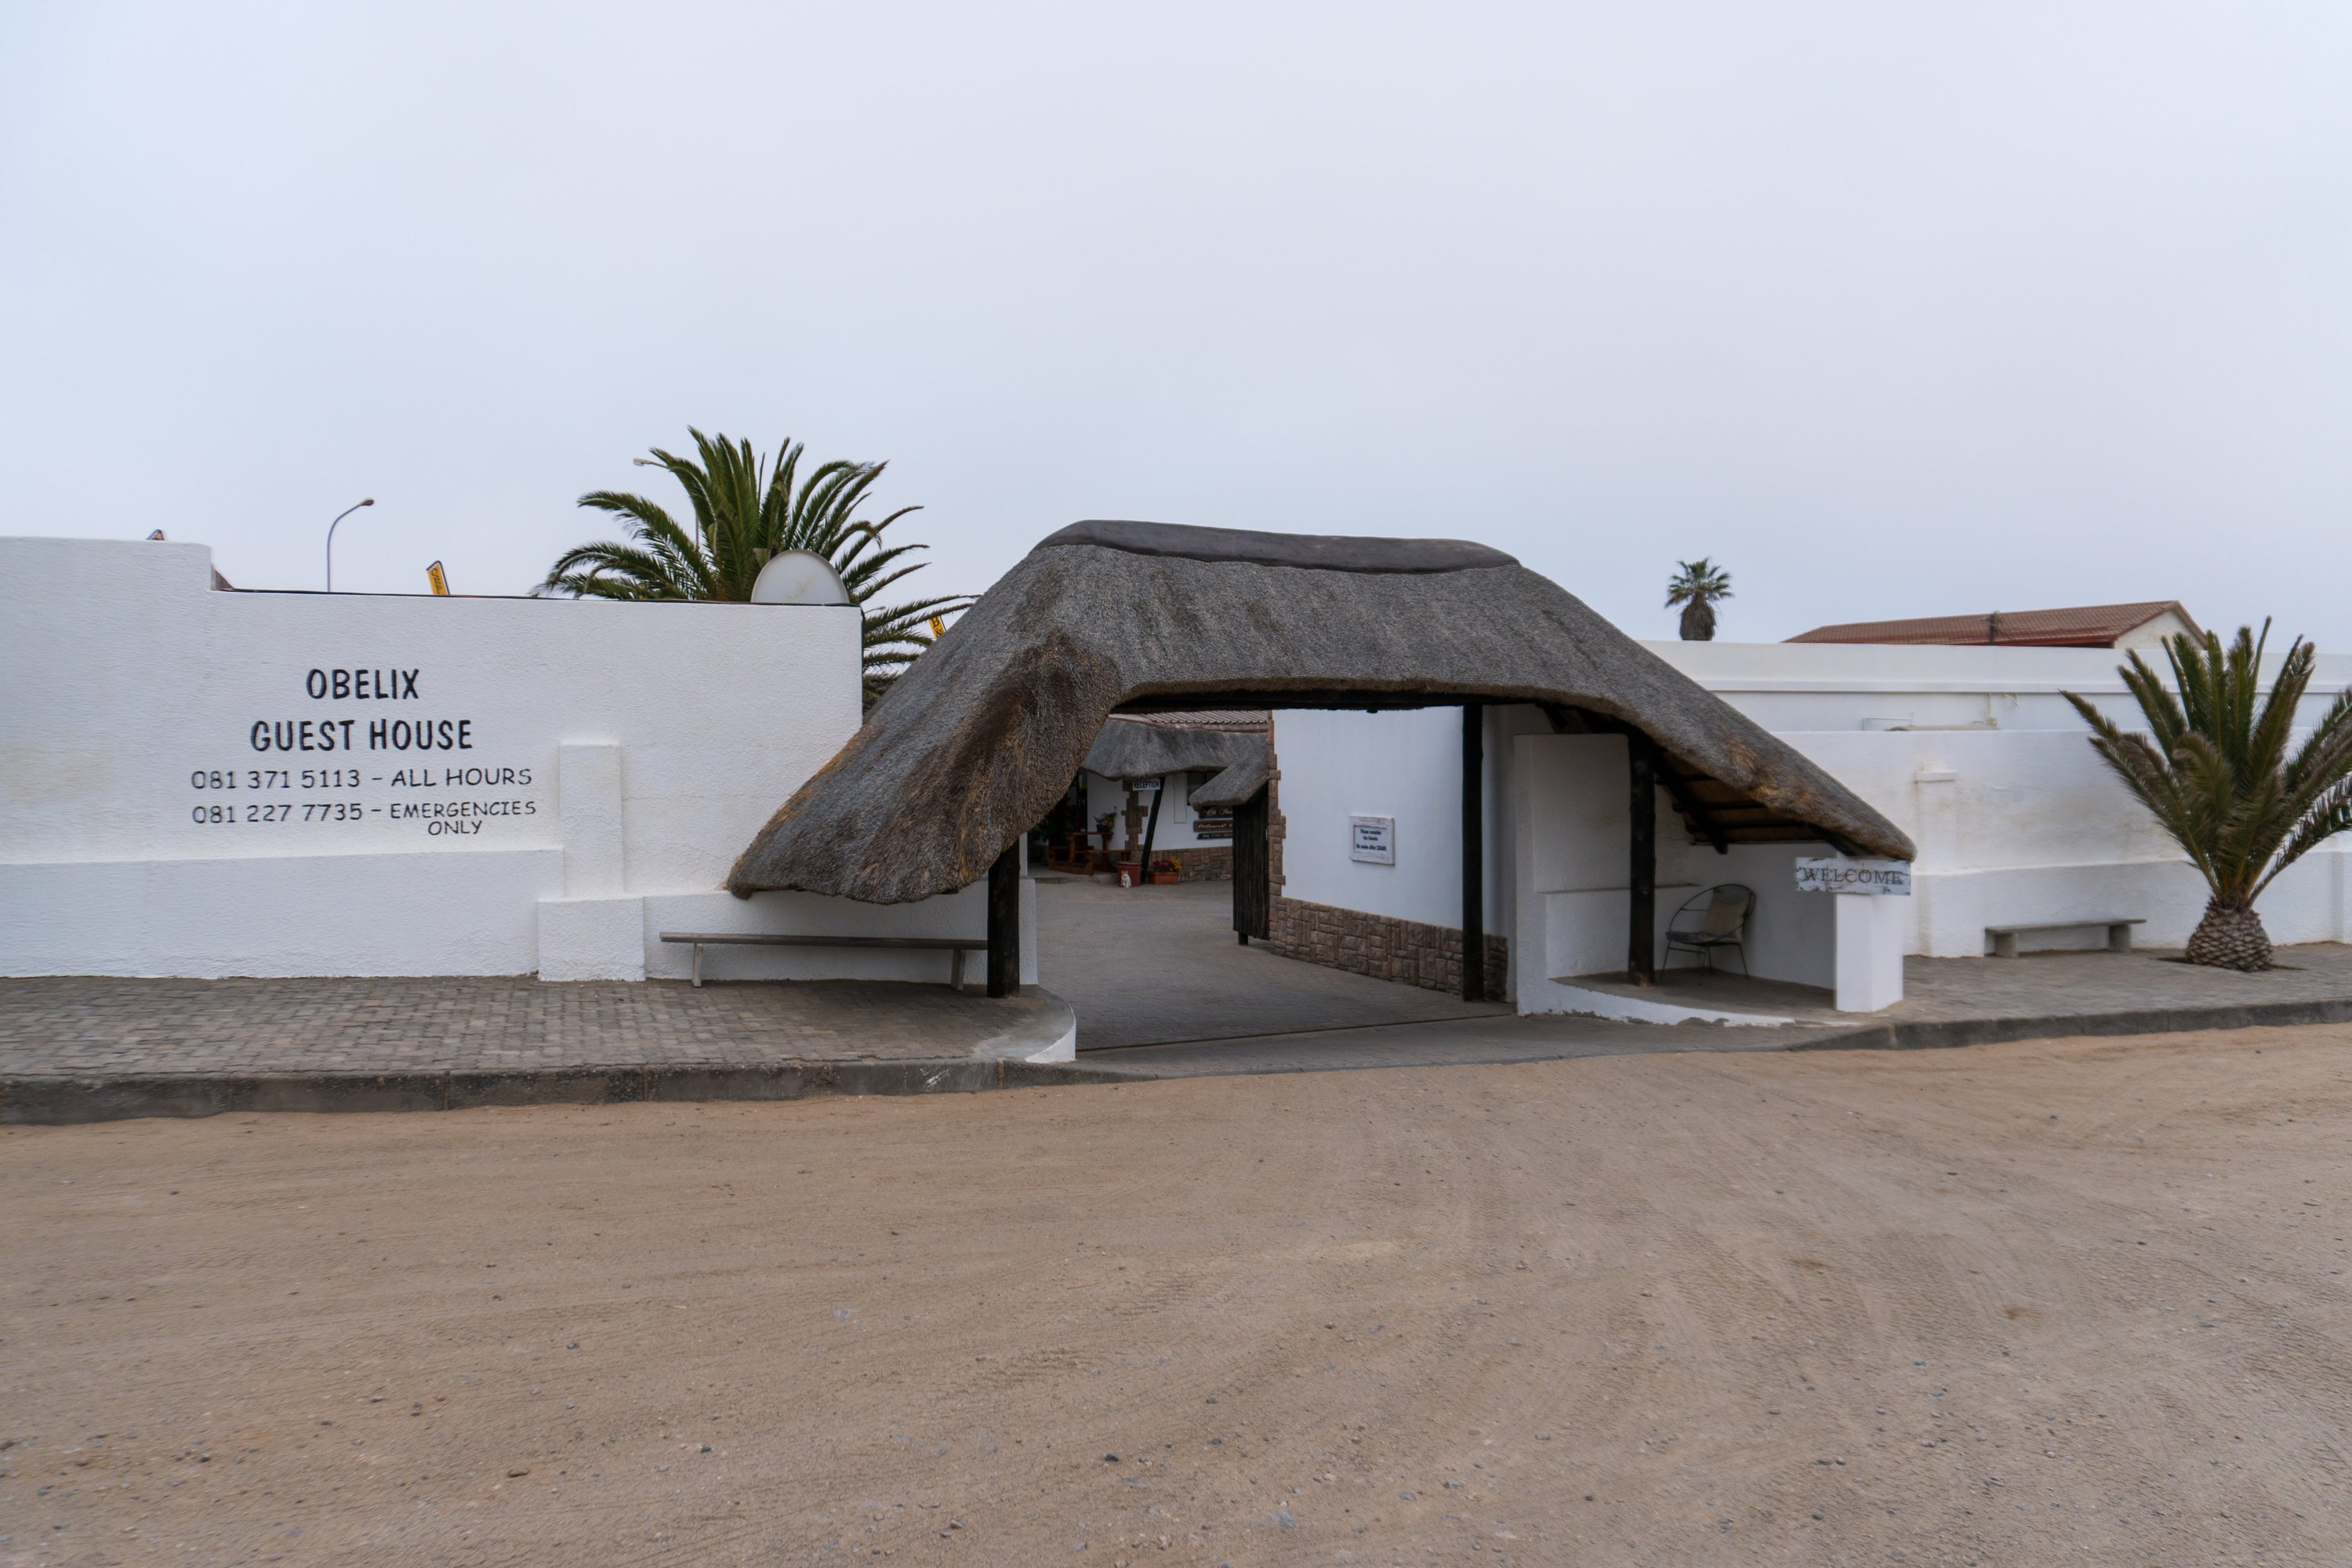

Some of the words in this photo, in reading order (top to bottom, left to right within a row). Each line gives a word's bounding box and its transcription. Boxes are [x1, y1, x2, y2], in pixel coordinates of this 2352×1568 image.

[306, 668, 420, 700] OBELIX
[249, 719, 356, 753] GUEST
[368, 718, 474, 751] HOUSE
[191, 770, 238, 790] 081
[247, 770, 291, 789] 371
[301, 768, 361, 789] 5113
[390, 768, 437, 788] ALL
[445, 768, 532, 786] HOURS
[1134, 779, 1160, 789] RECEPTION
[191, 805, 236, 825] 081
[246, 804, 292, 822] 227
[301, 803, 363, 822] 7735
[390, 800, 536, 819] EMERGENCIES
[427, 820, 483, 836] ONLY
[1802, 867, 1904, 884] WELCOME
